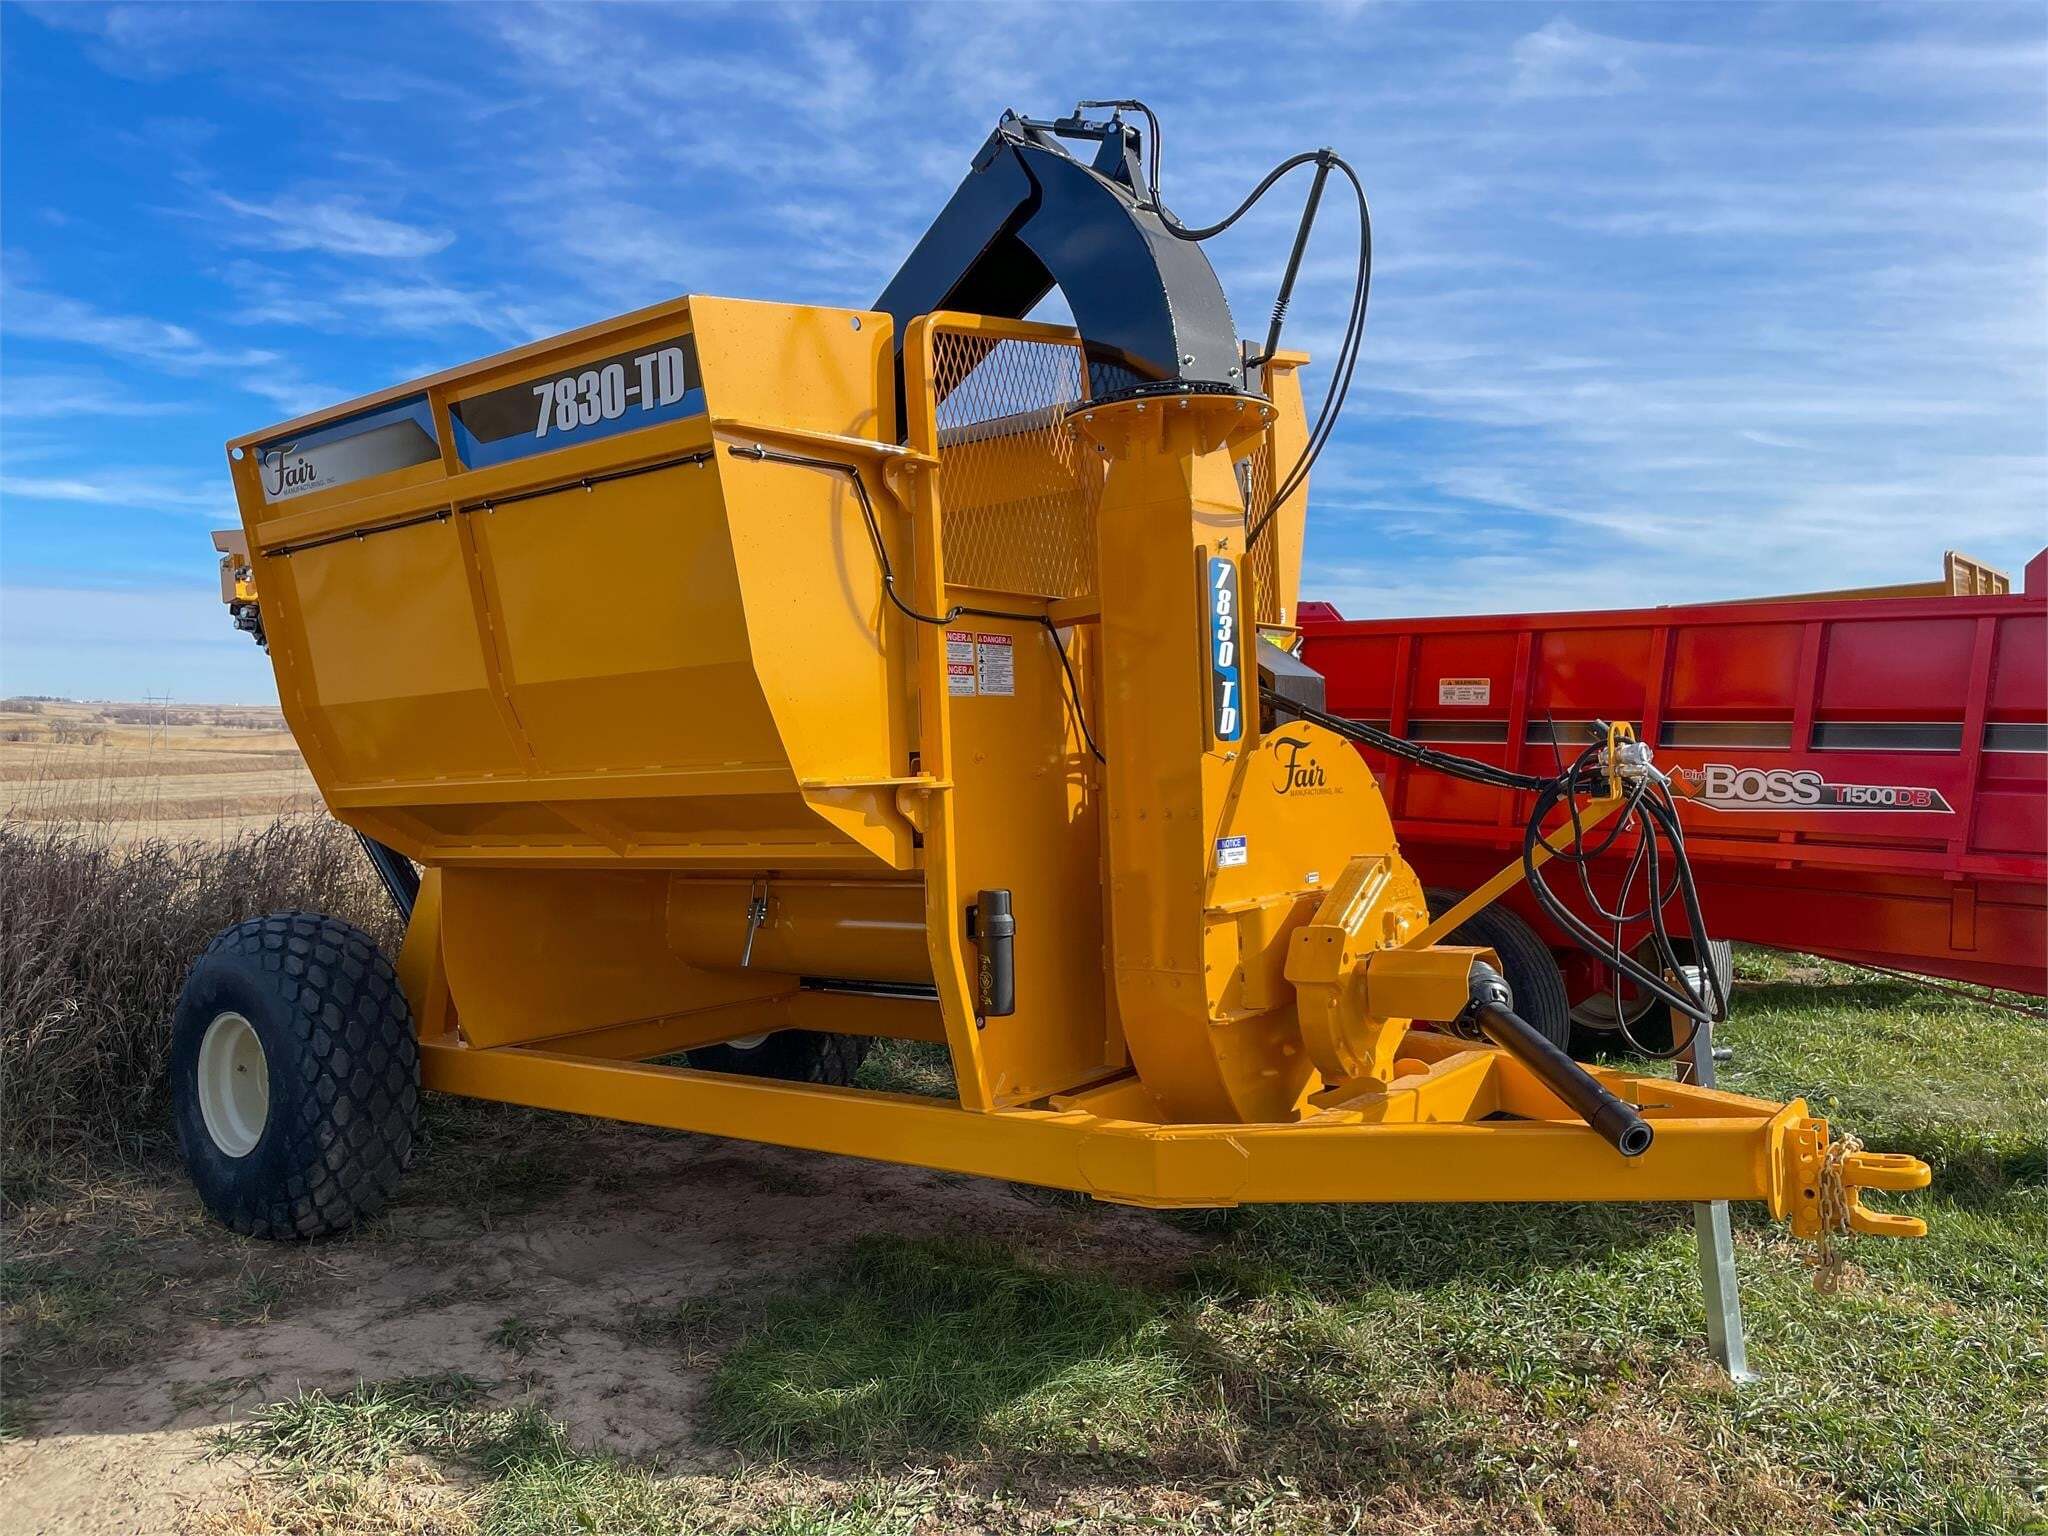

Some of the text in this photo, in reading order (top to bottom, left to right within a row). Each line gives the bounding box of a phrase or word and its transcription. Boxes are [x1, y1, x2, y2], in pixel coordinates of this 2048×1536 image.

[533, 347, 685, 438] 7830-TD
[264, 442, 317, 496] Fair
[947, 632, 967, 642] NGER
[983, 635, 1007, 644] DANGER
[1215, 563, 1236, 734] 7830 TD
[948, 665, 968, 674] NGER
[1272, 736, 1327, 794] Fair
[1705, 766, 1932, 807] BOSS T1500DB
[1221, 838, 1241, 848] NOTICE
